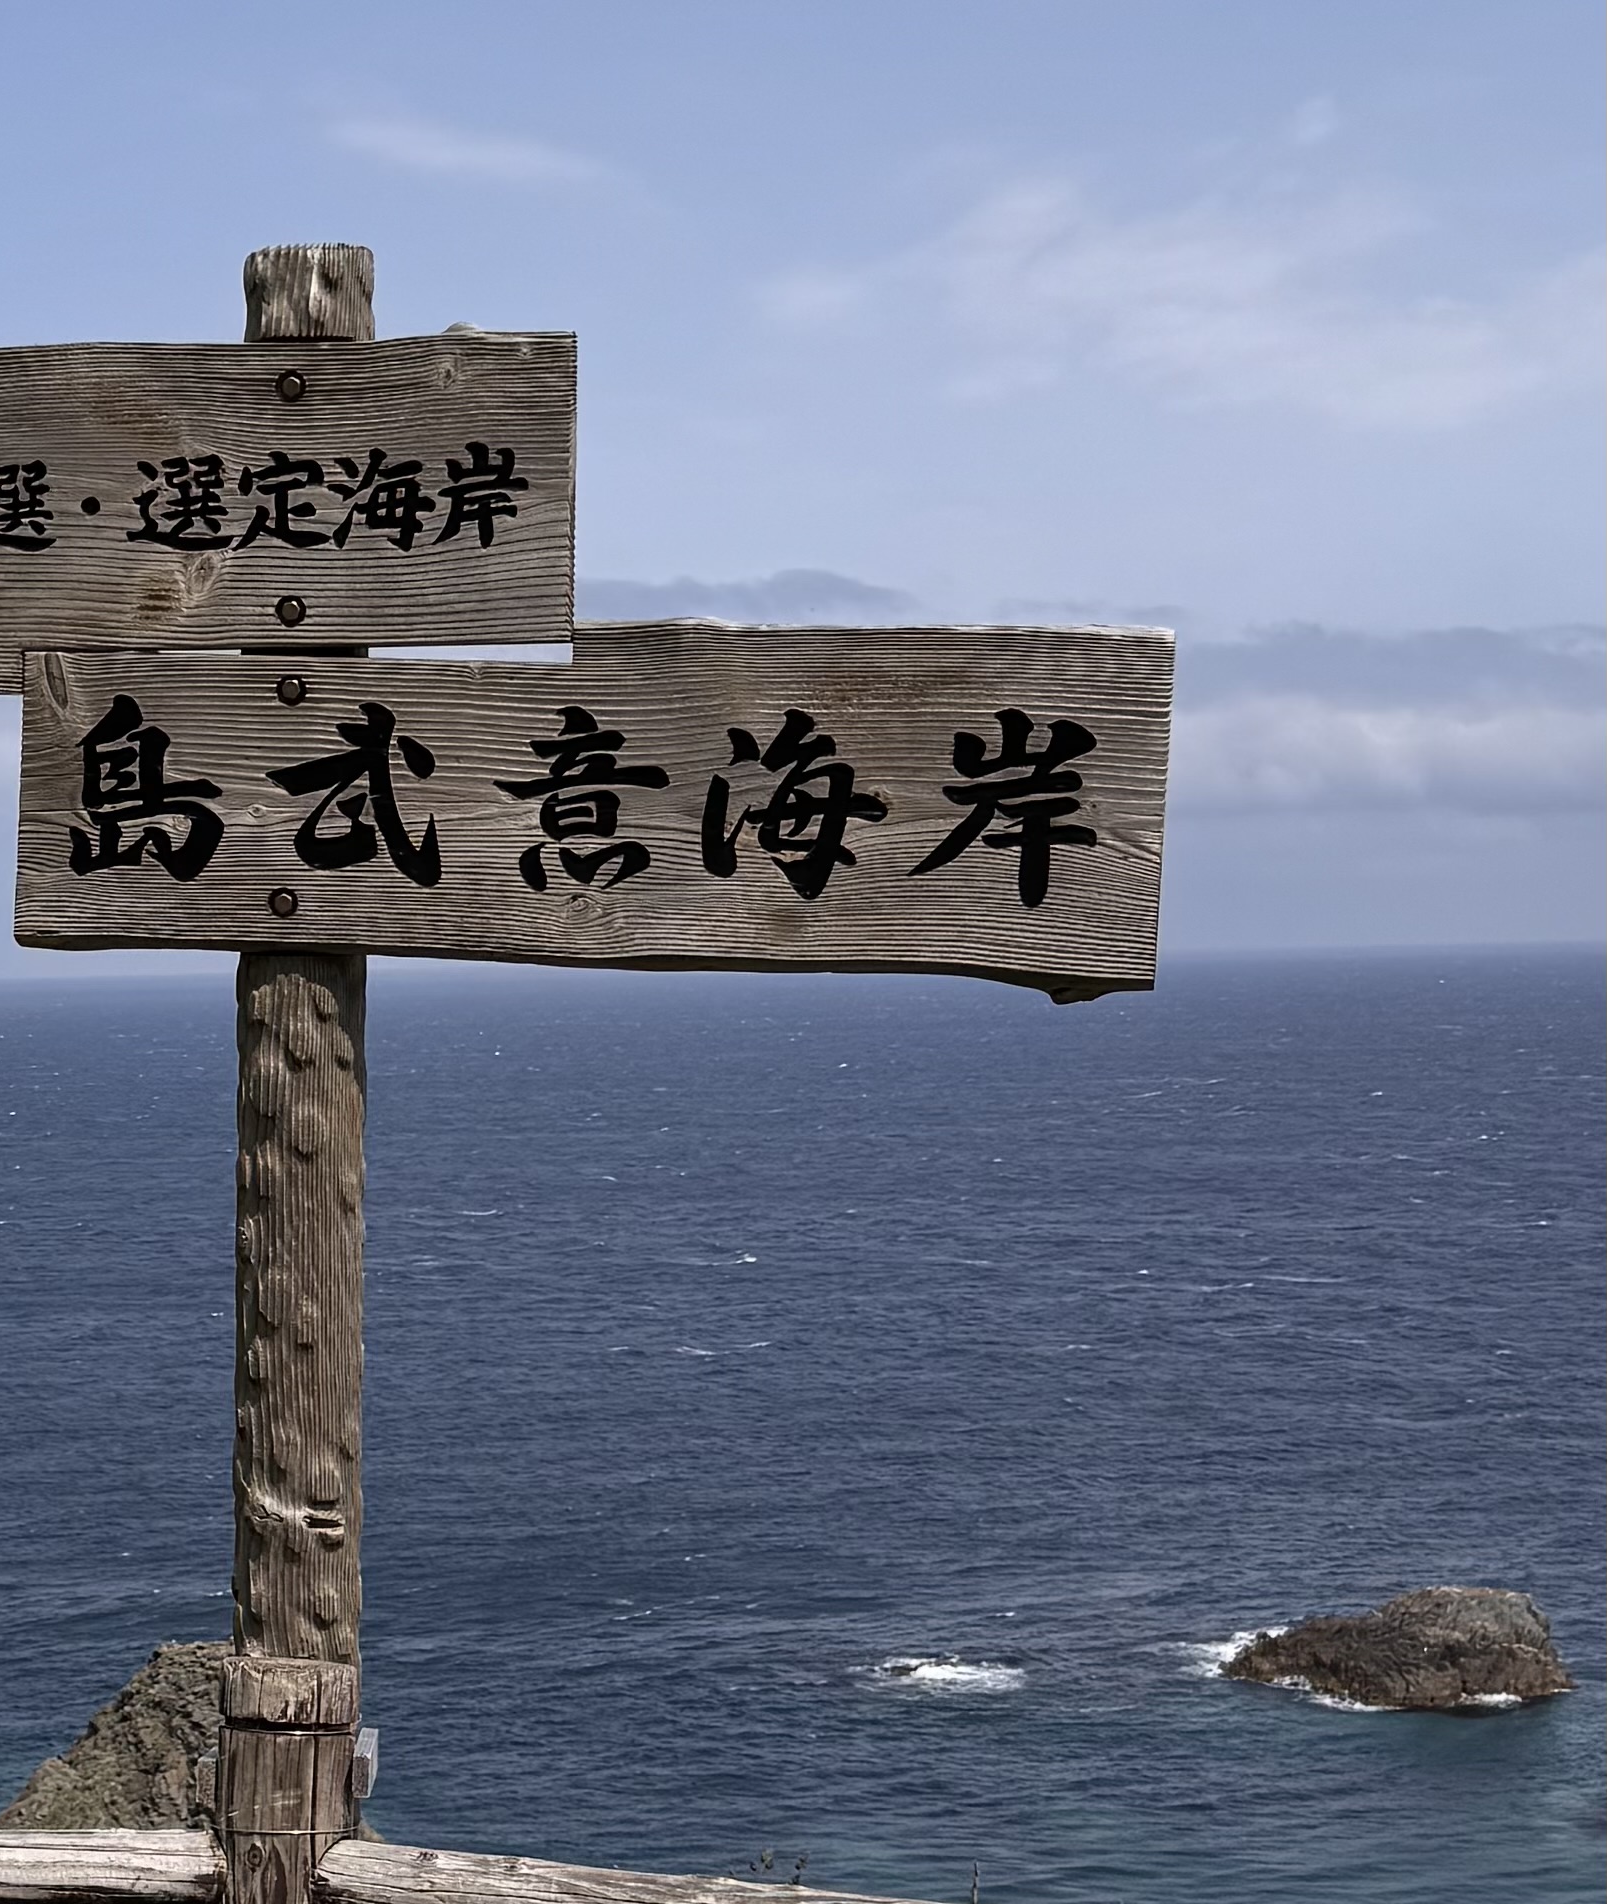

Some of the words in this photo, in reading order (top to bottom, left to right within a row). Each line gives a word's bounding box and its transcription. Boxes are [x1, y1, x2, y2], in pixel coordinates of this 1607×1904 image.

[66, 693, 1098, 908] 島武意海岸
